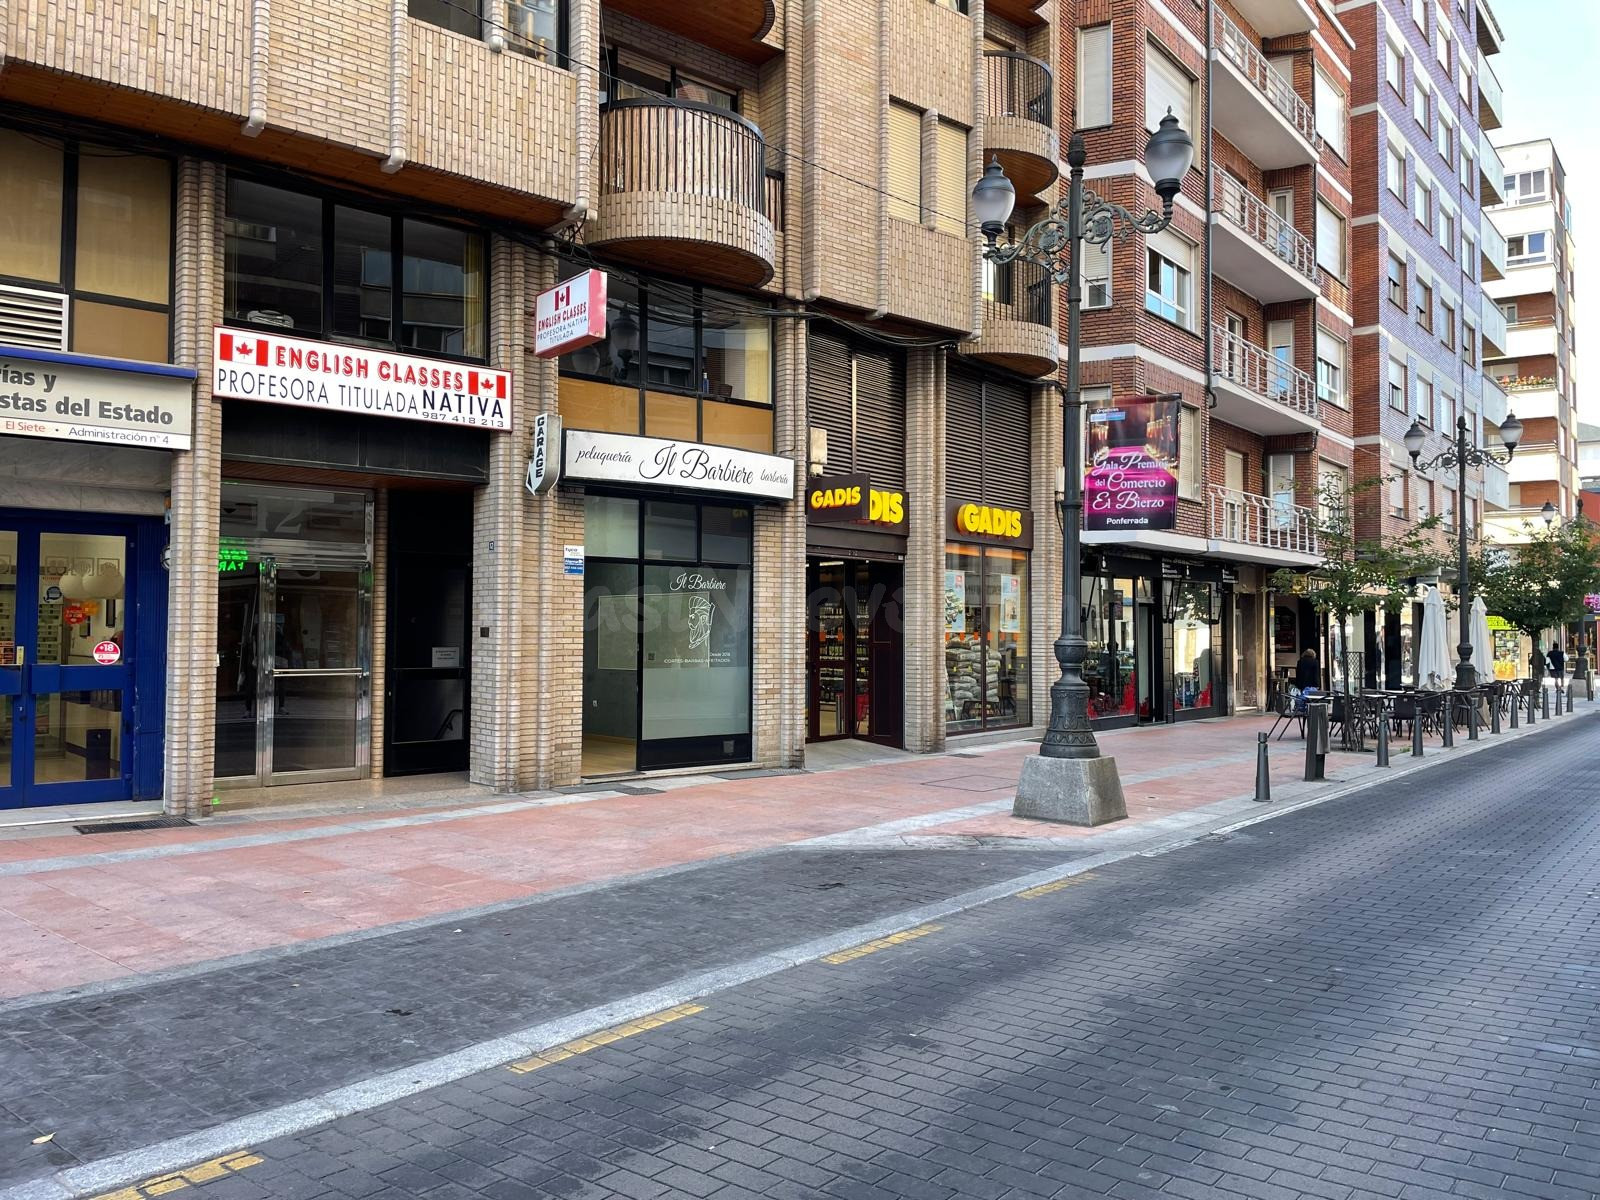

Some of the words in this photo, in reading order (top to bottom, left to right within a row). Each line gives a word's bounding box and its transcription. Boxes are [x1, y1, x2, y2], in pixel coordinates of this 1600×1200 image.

[537, 324, 566, 341] PROFESORA
[567, 316, 587, 328] NATIVA
[538, 313, 561, 331] ENGLISH
[562, 302, 587, 321] CLASSES
[275, 345, 369, 379] ENGLISH
[377, 360, 464, 392] CLASSES
[43, 374, 57, 393] y
[218, 368, 329, 404] PROFESORA
[338, 384, 418, 415] TITULADA
[423, 389, 504, 419] NATIVA
[55, 396, 90, 417] del
[99, 401, 173, 425] Estado
[422, 411, 447, 421] 987
[452, 416, 476, 425] 418
[481, 419, 504, 428] 213
[6, 421, 15, 430] El
[18, 422, 46, 433] Siete
[69, 427, 148, 443] Administración
[162, 435, 169, 444] 4
[535, 416, 545, 479] GARAGE
[575, 445, 633, 466] peluquería
[680, 448, 754, 485] Barbiere
[1091, 452, 1118, 476] Gala
[1119, 451, 1169, 470] Premios
[1095, 479, 1106, 487] del
[1107, 471, 1166, 491] Comercio
[811, 486, 862, 510] GADIS
[1092, 491, 1111, 511] El
[1115, 491, 1164, 510] Bierzo
[958, 503, 1022, 538] GADIS
[1106, 517, 1149, 525] Ponferrada
[688, 574, 727, 590] Barbiere
